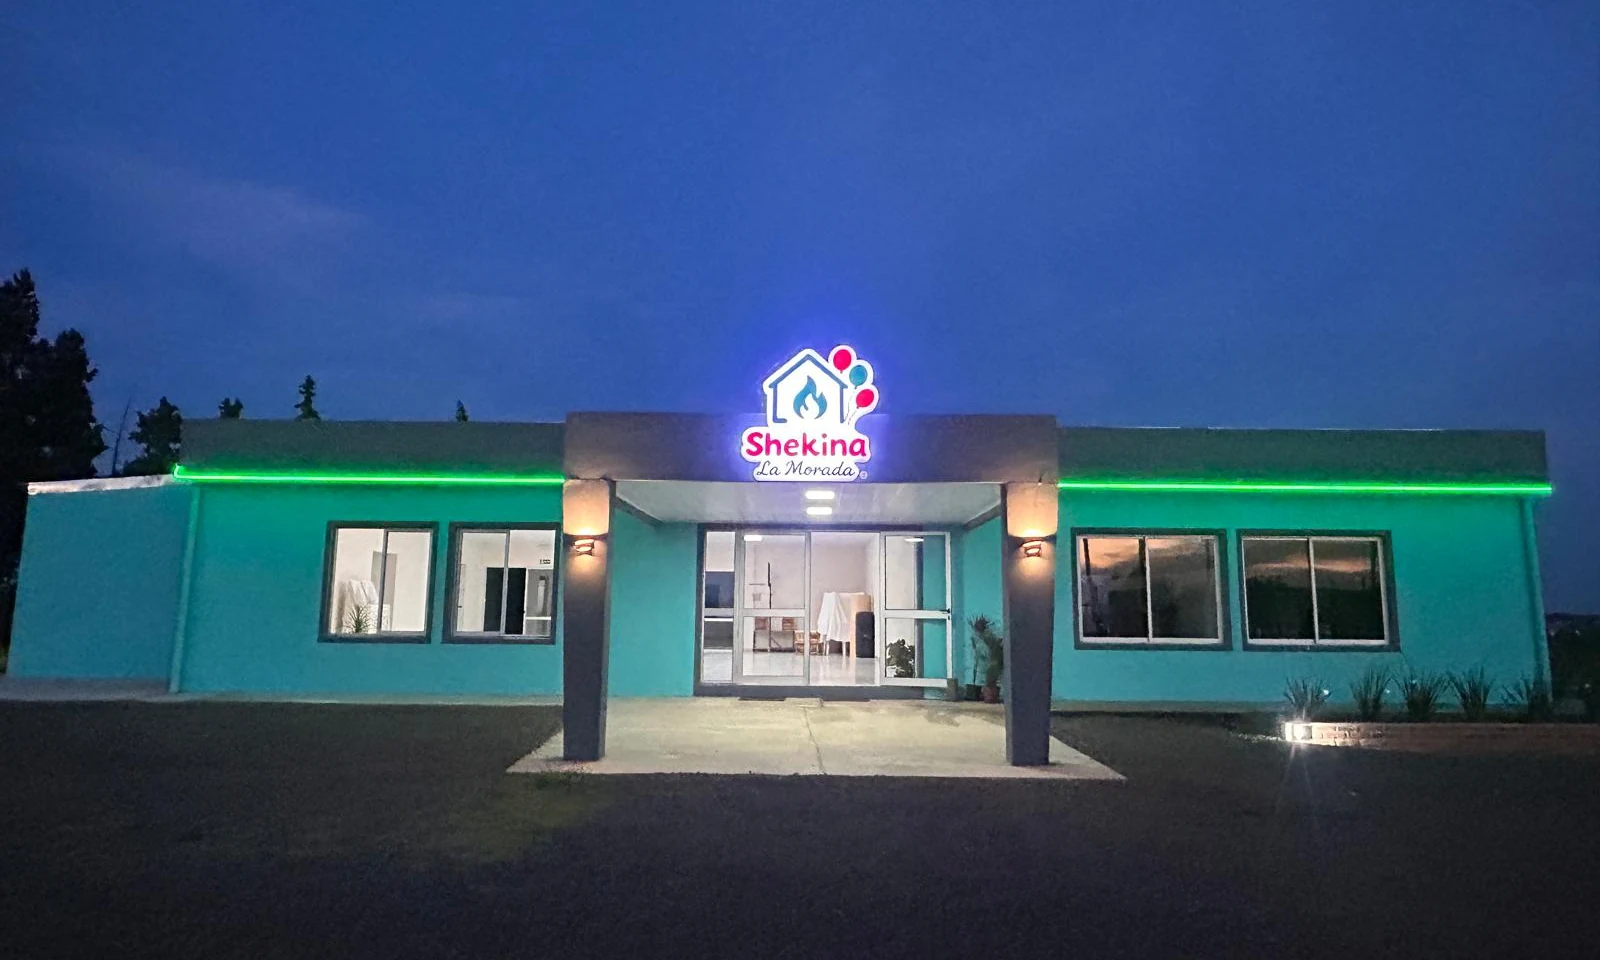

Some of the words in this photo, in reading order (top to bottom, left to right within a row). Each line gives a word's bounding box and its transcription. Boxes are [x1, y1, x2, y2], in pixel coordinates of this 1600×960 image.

[746, 432, 866, 456] Shekina
[756, 460, 781, 476] La
[785, 460, 855, 476] Morada
